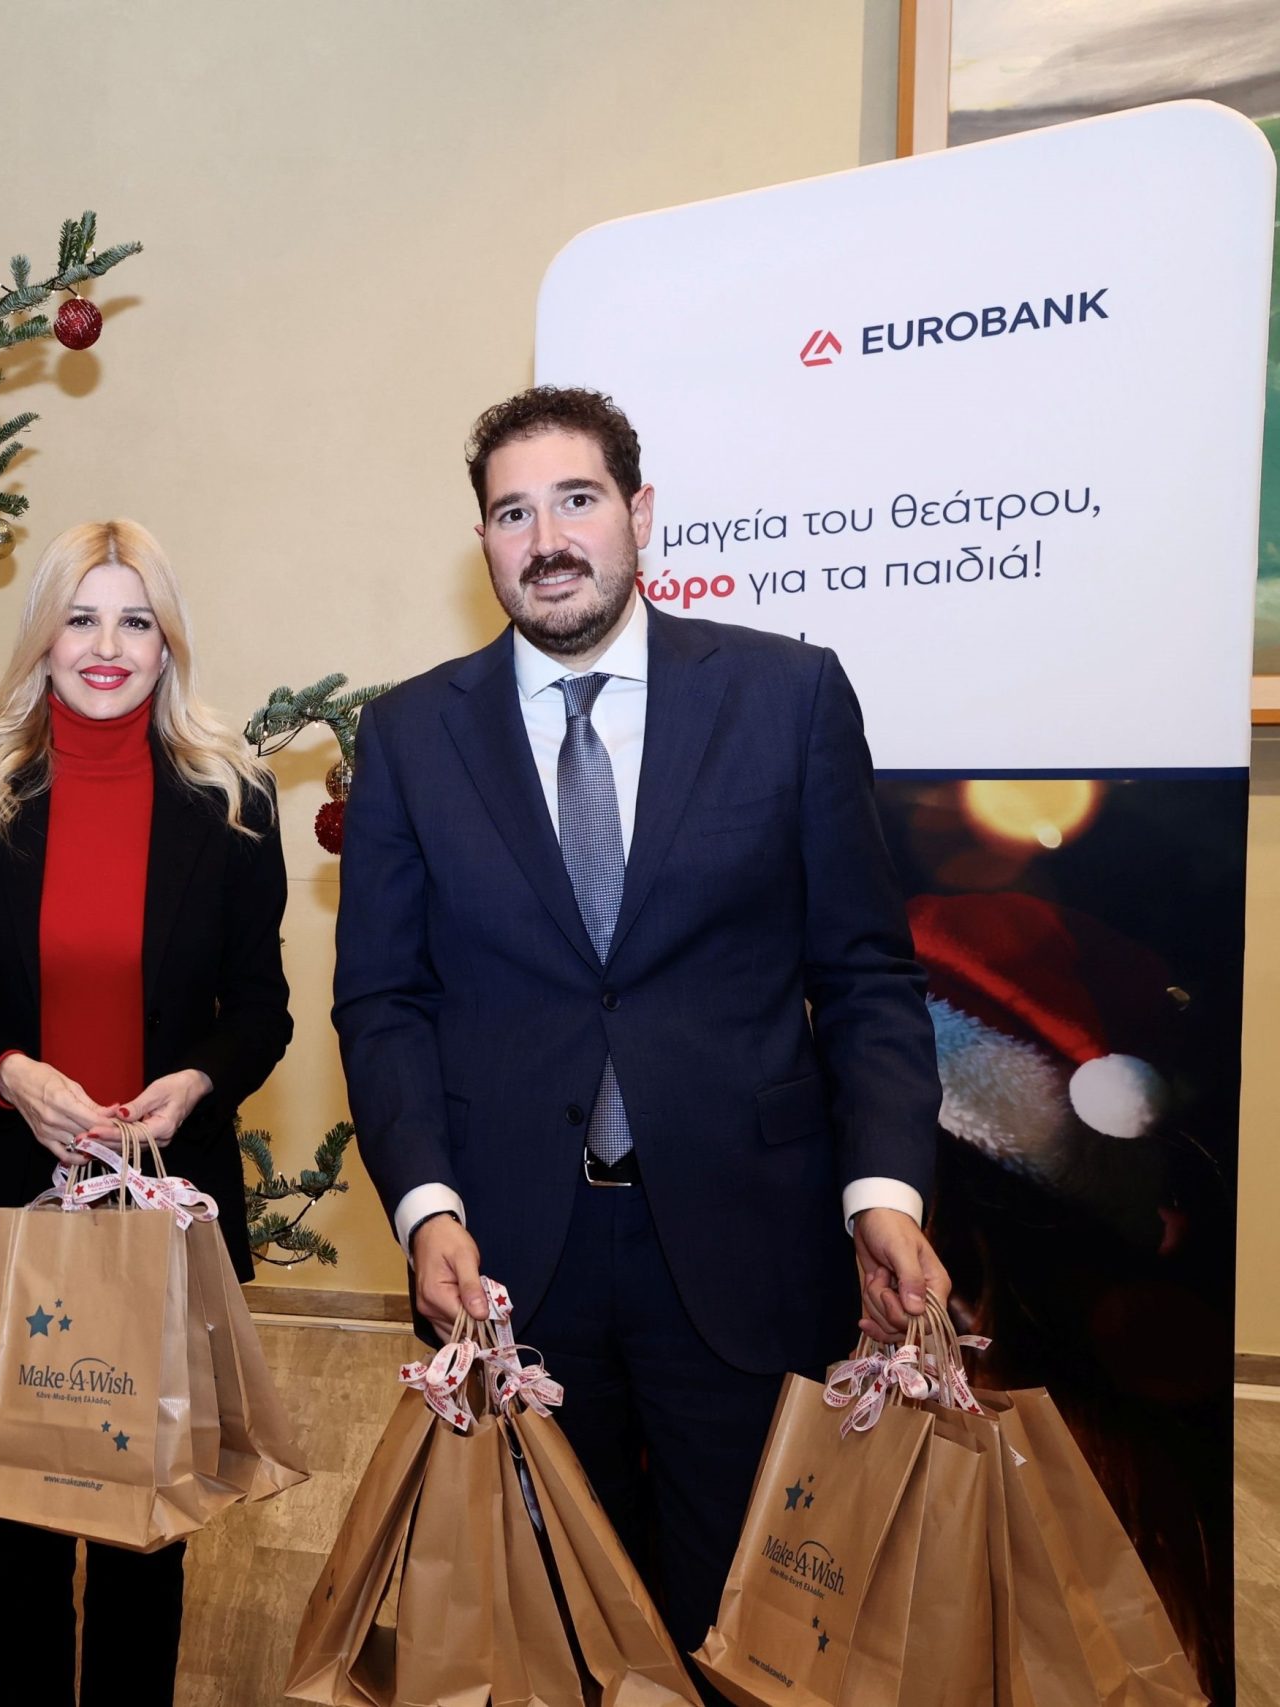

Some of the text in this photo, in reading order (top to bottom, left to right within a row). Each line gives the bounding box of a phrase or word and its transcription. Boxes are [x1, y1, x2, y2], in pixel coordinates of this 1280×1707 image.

[862, 288, 1110, 355] EUROBANK
[662, 487, 1102, 557] μαγεία του θεάτρου,
[748, 568, 806, 605] για
[821, 560, 867, 592] τα
[885, 540, 1043, 588] παιδιά!
